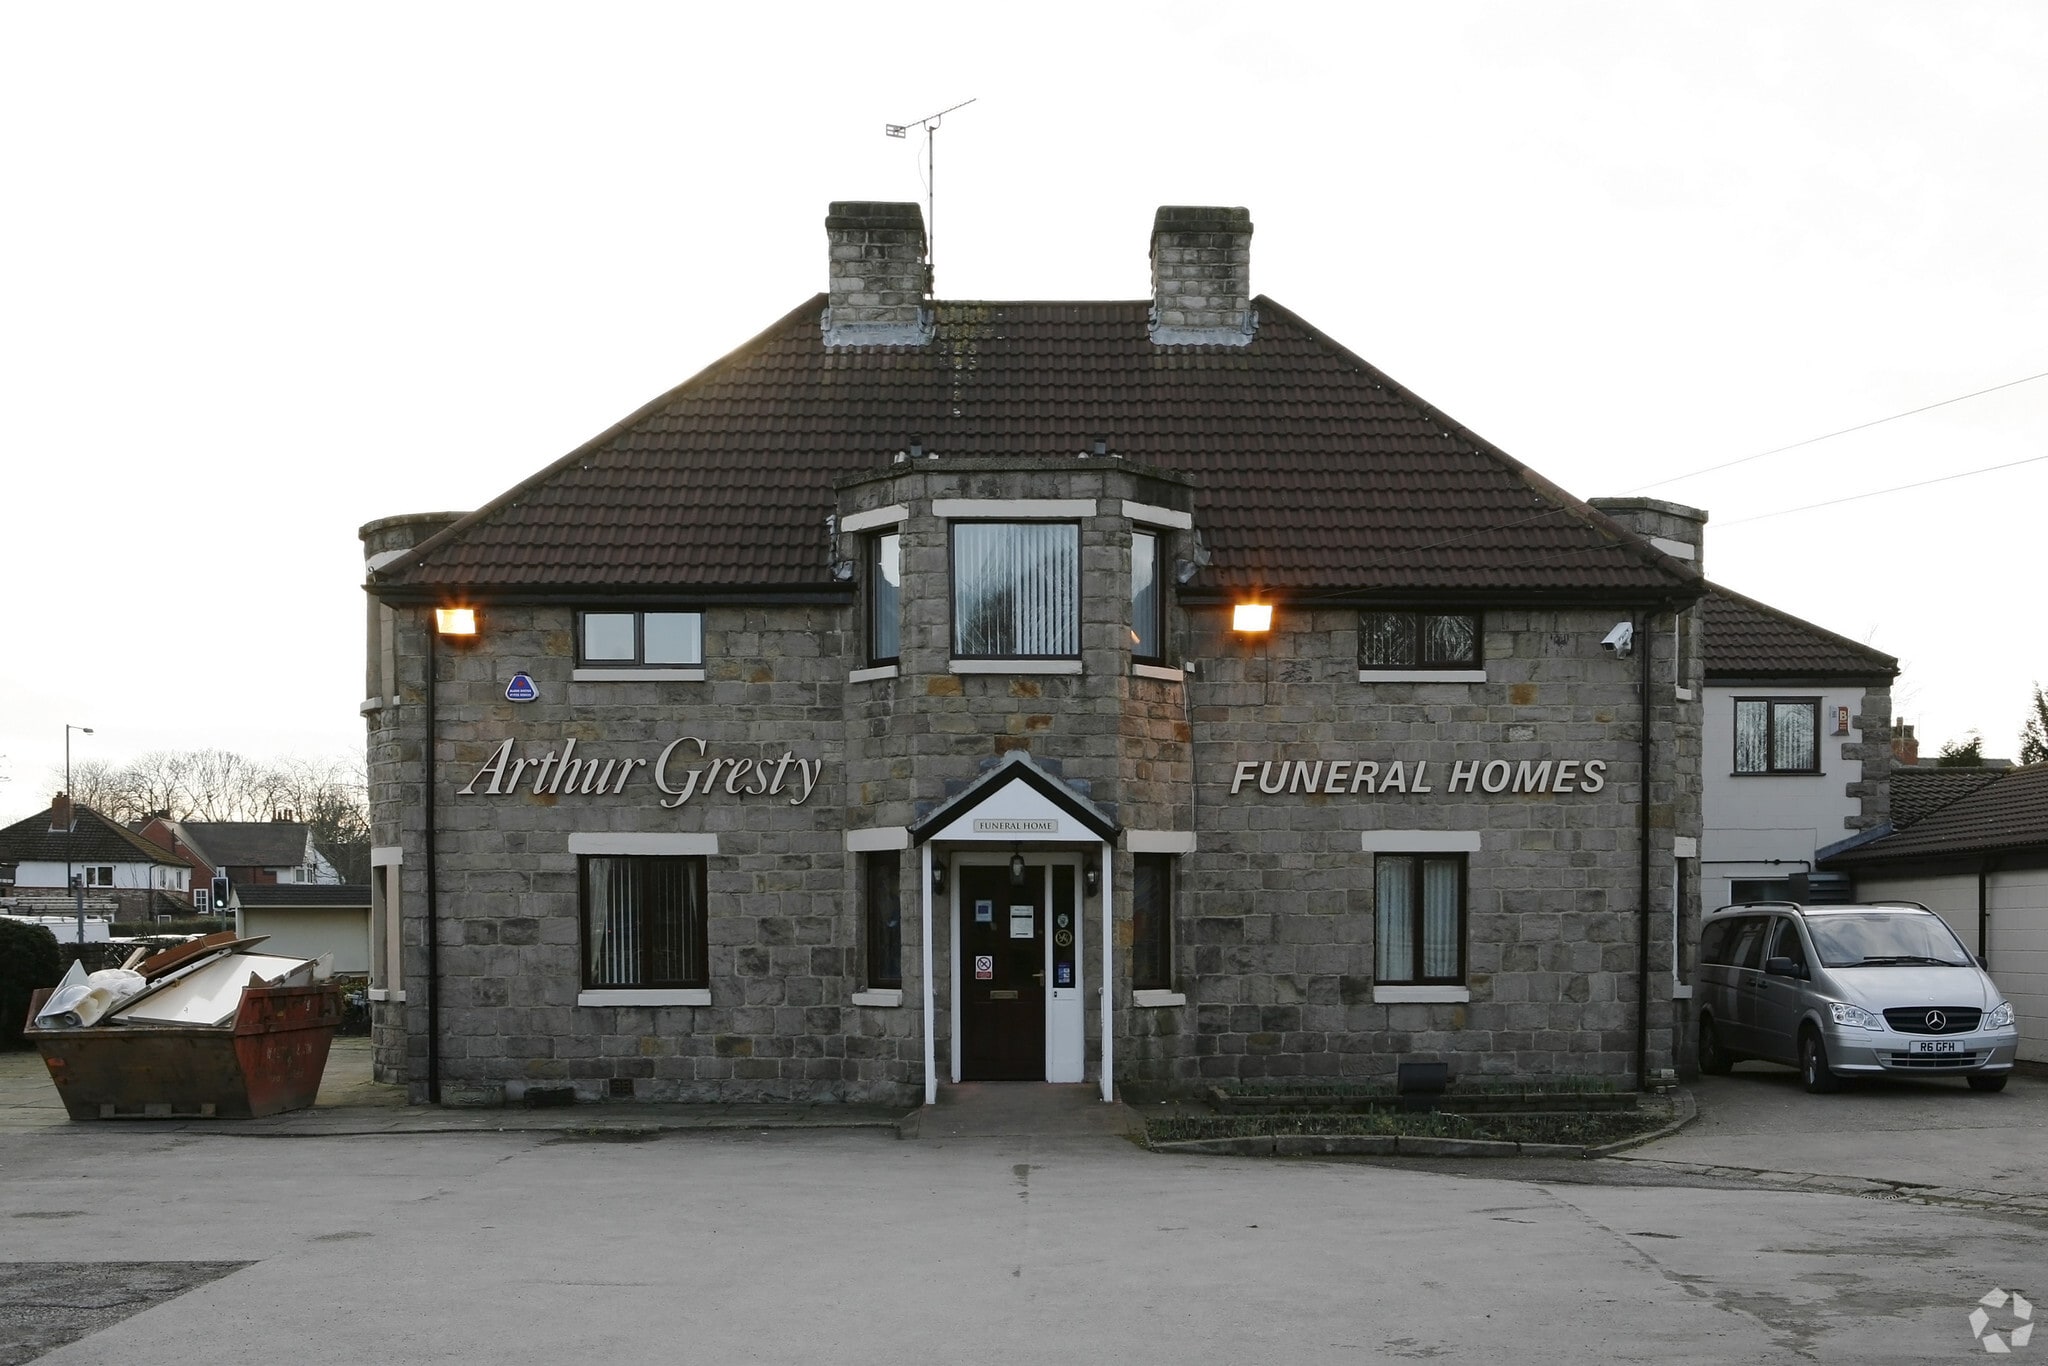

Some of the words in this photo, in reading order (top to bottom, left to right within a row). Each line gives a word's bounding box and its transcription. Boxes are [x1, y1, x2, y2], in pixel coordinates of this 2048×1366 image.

[1839, 710, 1847, 721] B
[457, 737, 646, 795] Arthur
[655, 737, 823, 808] Gresty
[1230, 760, 1432, 794] FUNERAL
[1447, 759, 1607, 794] HOMES
[979, 821, 1020, 830] FUNERAL
[1023, 821, 1052, 830] HOME
[1920, 1042, 1934, 1052] R6
[1936, 1042, 1955, 1052] GFH
